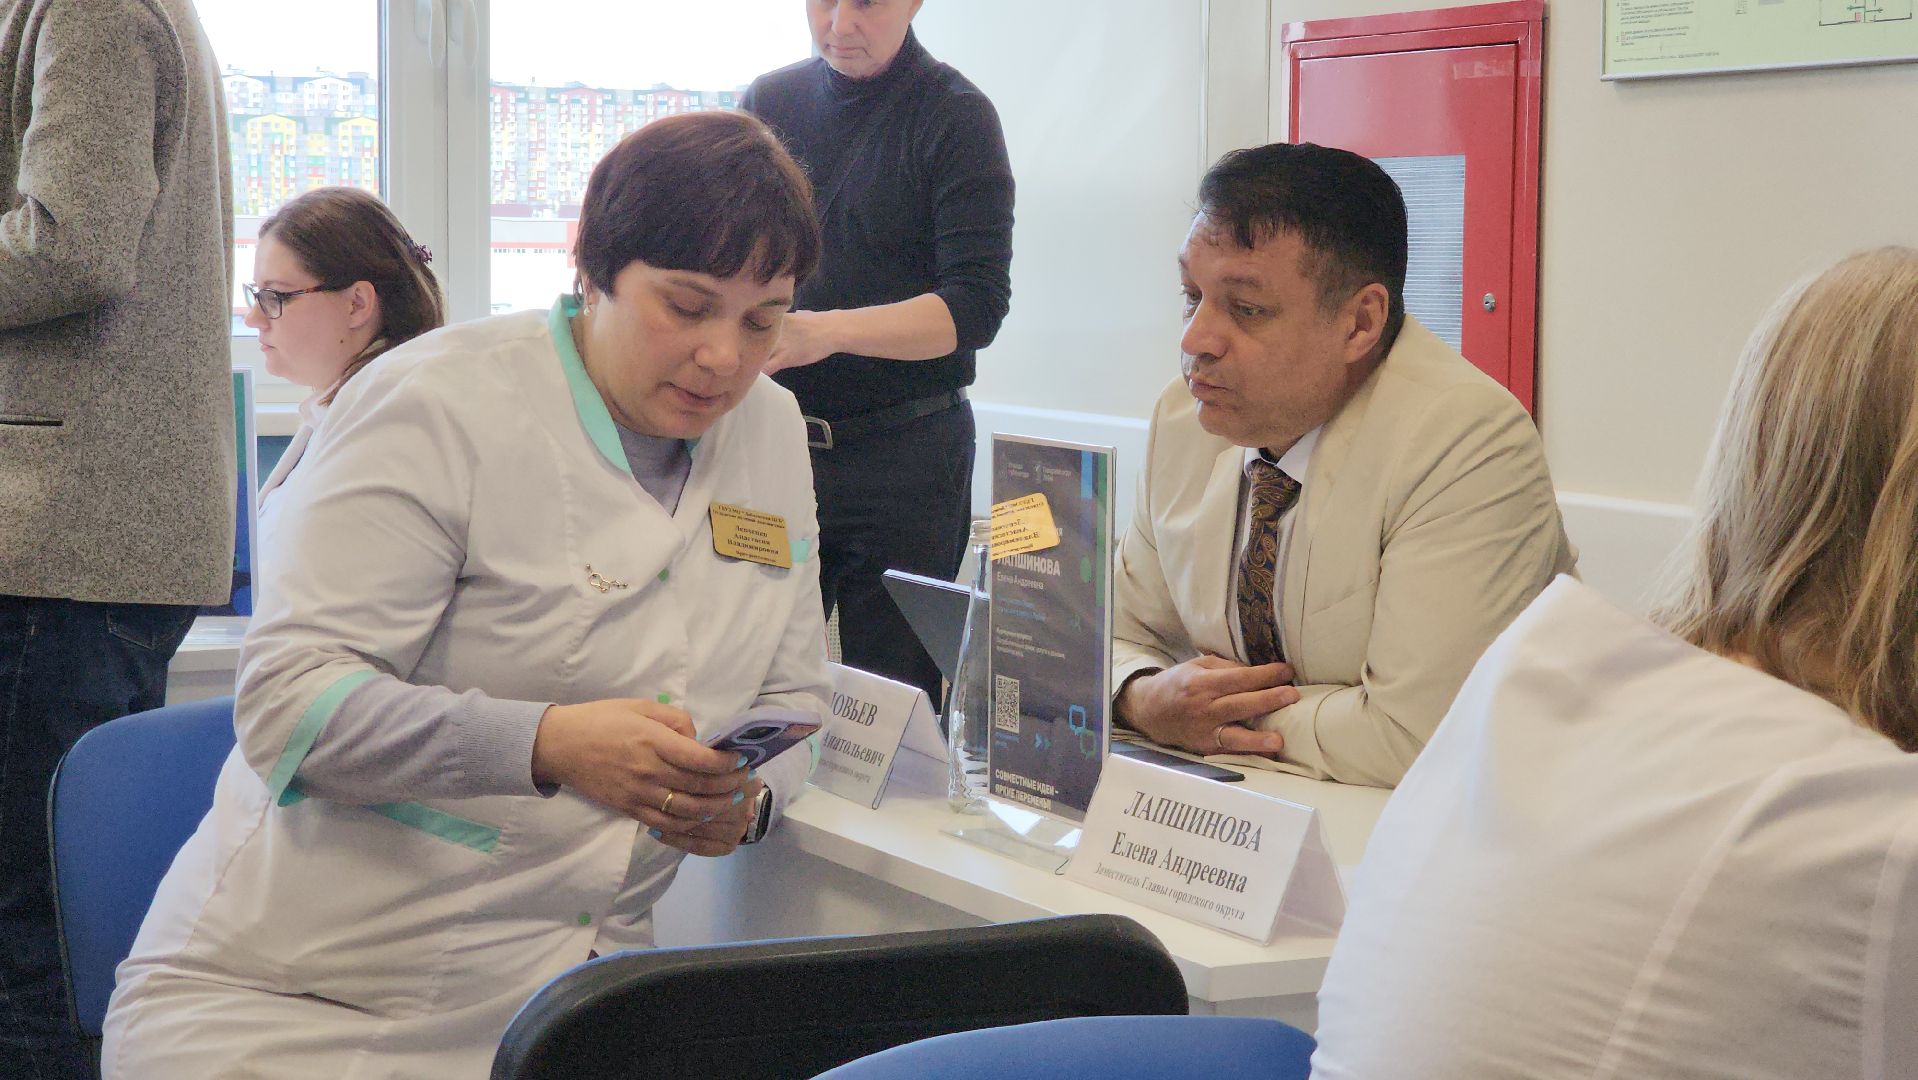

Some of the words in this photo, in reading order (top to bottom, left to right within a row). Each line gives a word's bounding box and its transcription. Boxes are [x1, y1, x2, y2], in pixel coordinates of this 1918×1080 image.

[728, 539, 779, 554] Владимировна
[997, 554, 1060, 576] ЛАПШИНОВА
[995, 769, 1036, 790] СОВМЕСТНЫЕ
[1037, 780, 1054, 796] ИДЕИ
[995, 784, 1015, 799] ЯРКИЕ
[1015, 789, 1052, 810] ПЕРЕМЕНЫ
[1124, 790, 1264, 852] ЛАПШИНОВА
[1110, 831, 1156, 866] Елена
[1158, 847, 1248, 894] Андреевна
[1094, 862, 1140, 888] Заместитель
[1140, 876, 1168, 896] Главы
[1168, 888, 1214, 911] городского
[1214, 904, 1246, 922] округа
